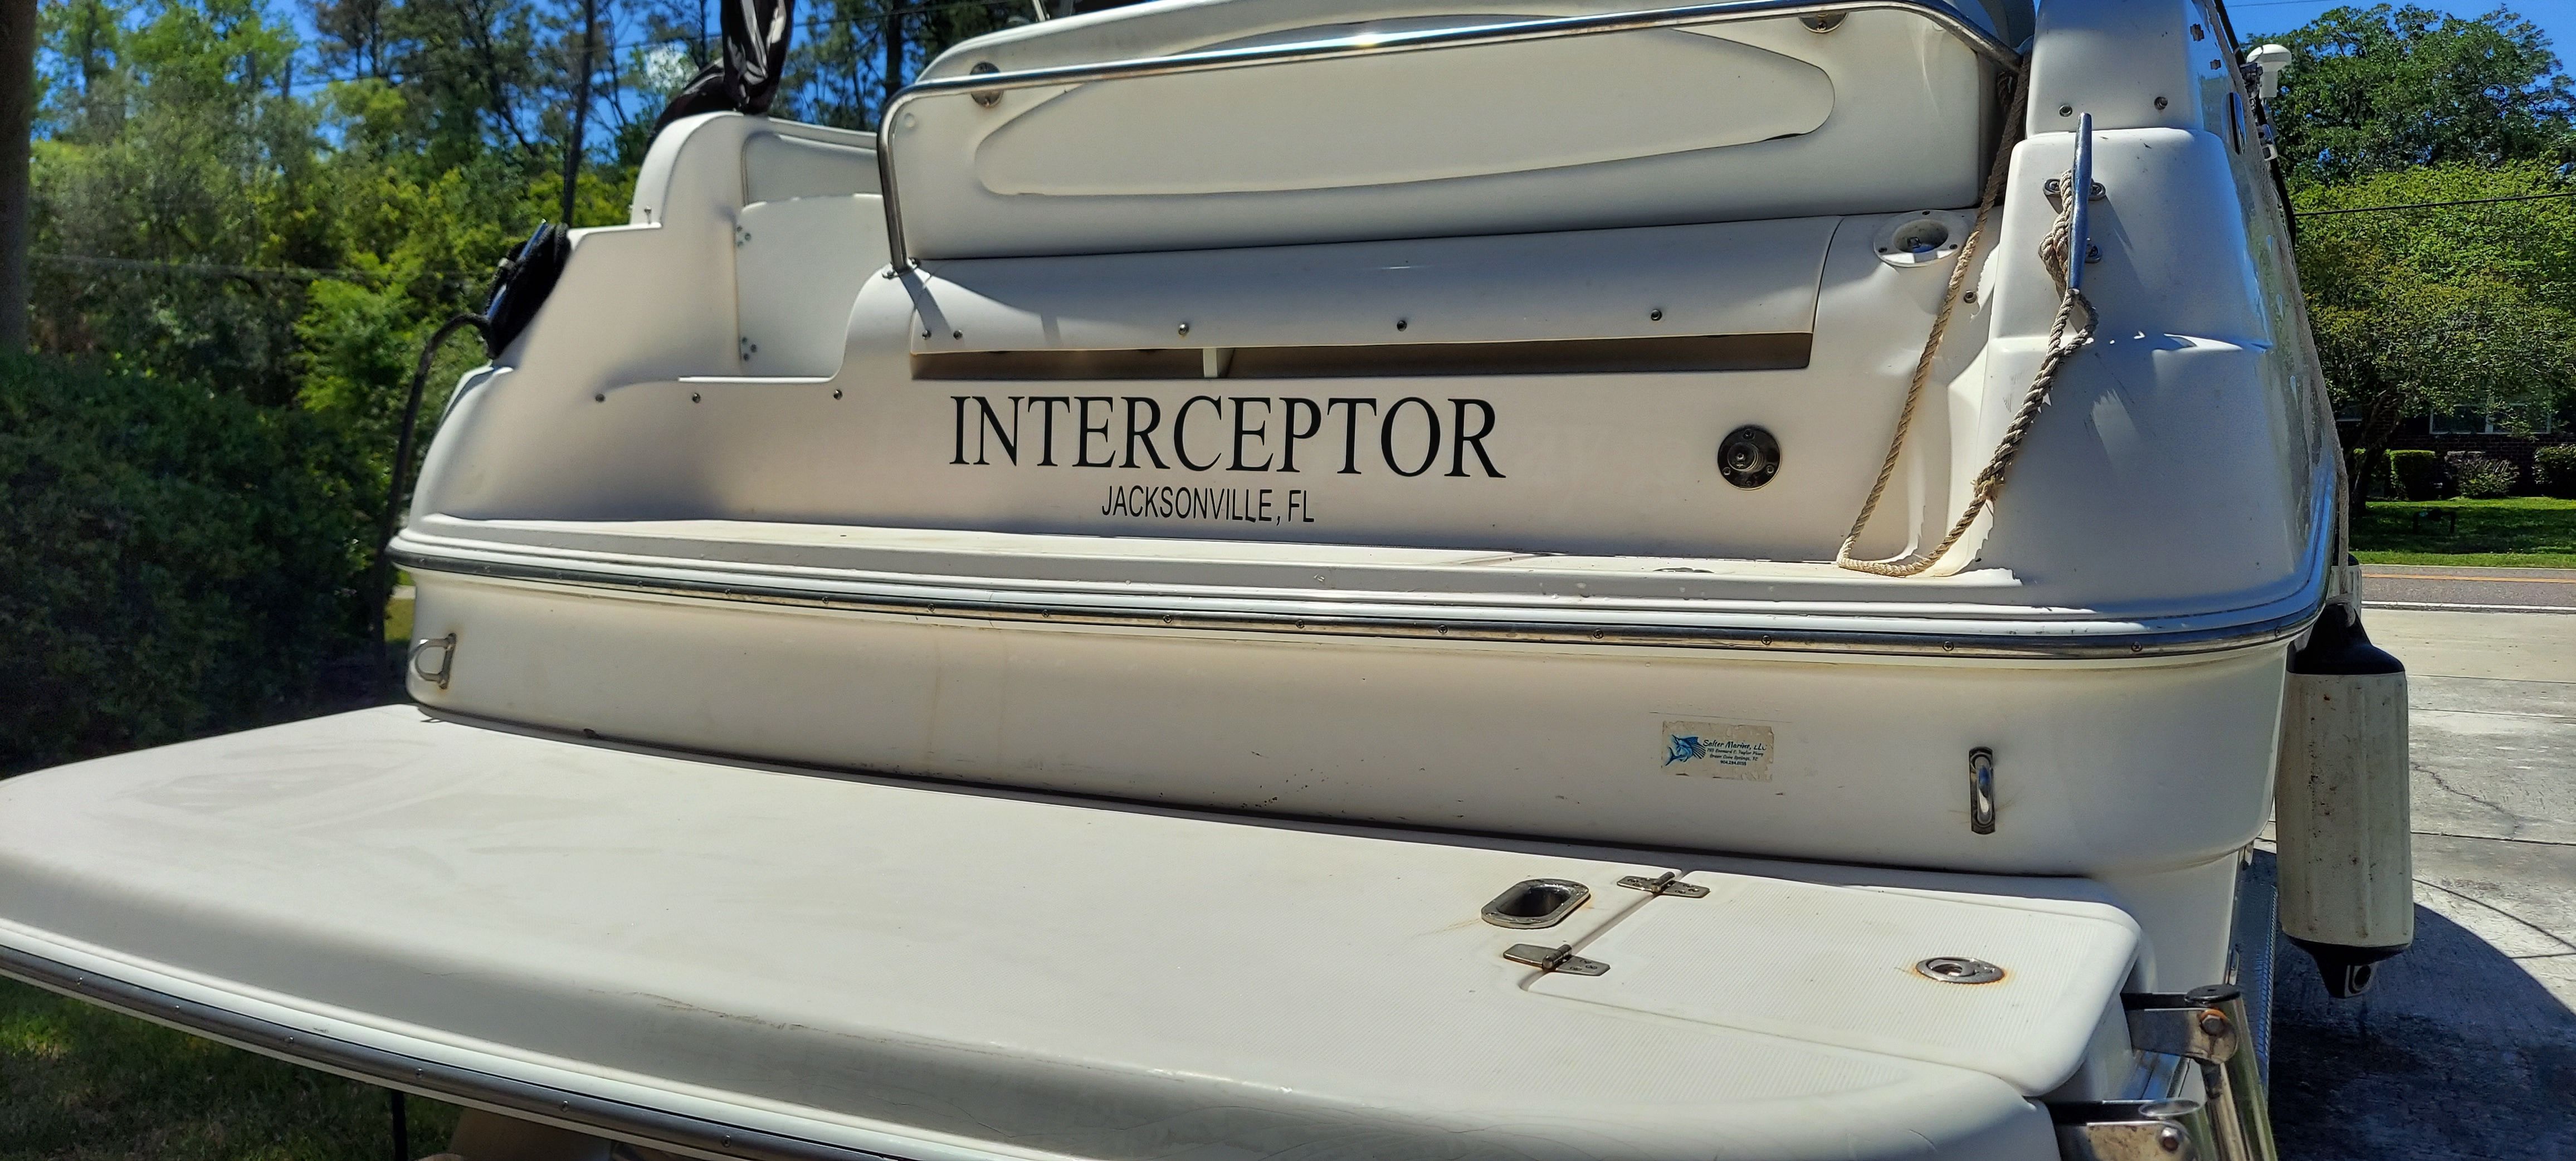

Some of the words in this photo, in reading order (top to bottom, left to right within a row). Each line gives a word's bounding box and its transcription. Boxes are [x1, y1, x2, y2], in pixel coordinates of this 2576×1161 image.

[949, 395, 1506, 479] INTERCEPTOR
[1101, 485, 1280, 526] JACKSONVILLE,
[1288, 490, 1315, 523] FL
[1725, 741, 1751, 750] Marine,
